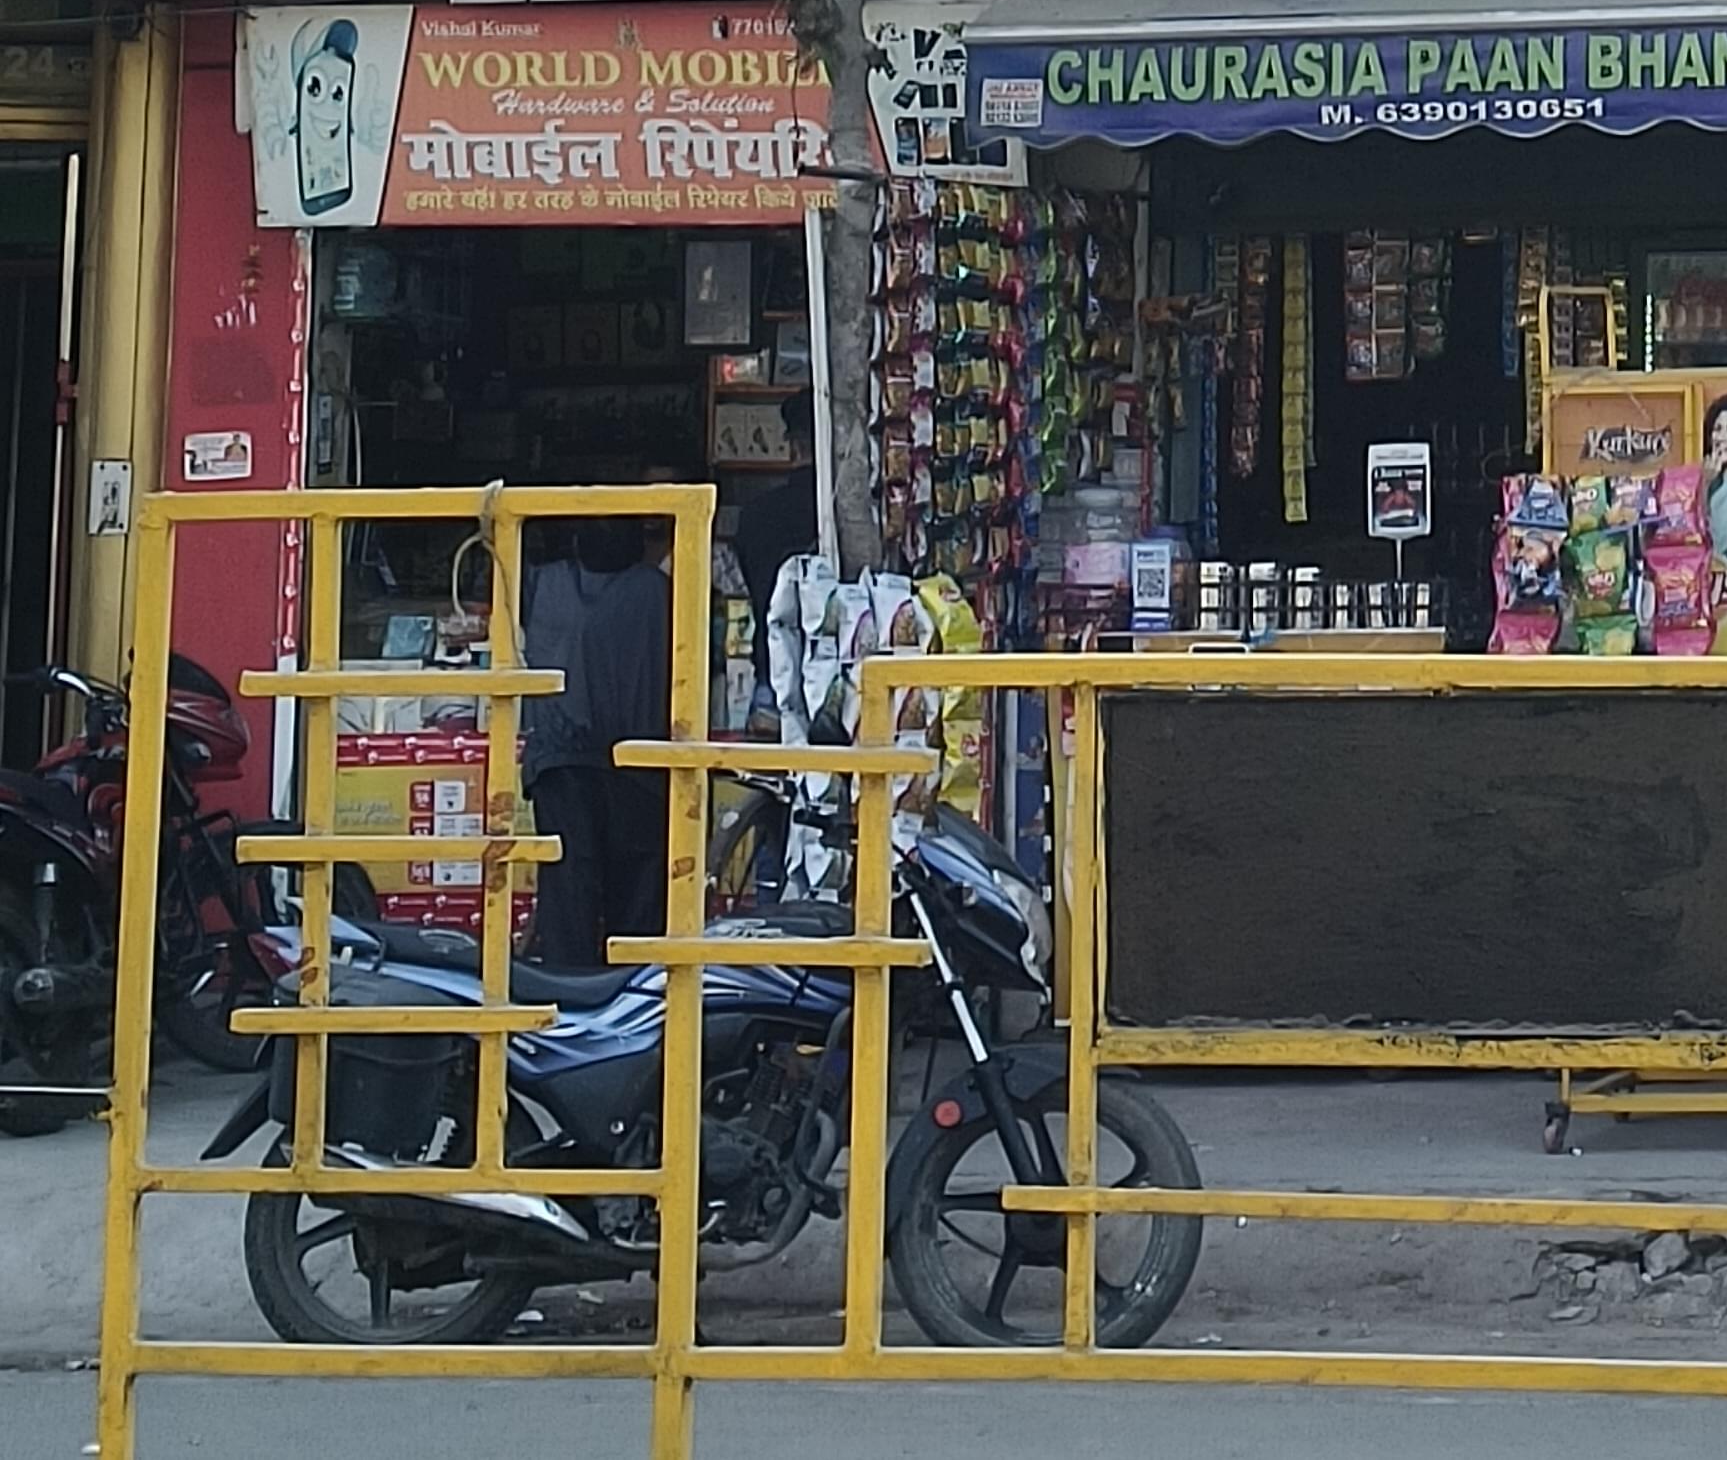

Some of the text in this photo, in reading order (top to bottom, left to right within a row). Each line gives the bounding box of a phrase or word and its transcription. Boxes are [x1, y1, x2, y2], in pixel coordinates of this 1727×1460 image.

[417, 47, 833, 88] WORLD MOBIL
[1046, 42, 1382, 105] CHAURASIA
[1407, 36, 1567, 94] PAAN
[492, 89, 775, 115] Hardware & Solution
[1320, 104, 1364, 126] M.
[401, 117, 623, 183] मोबाईल
[502, 190, 528, 210] हर
